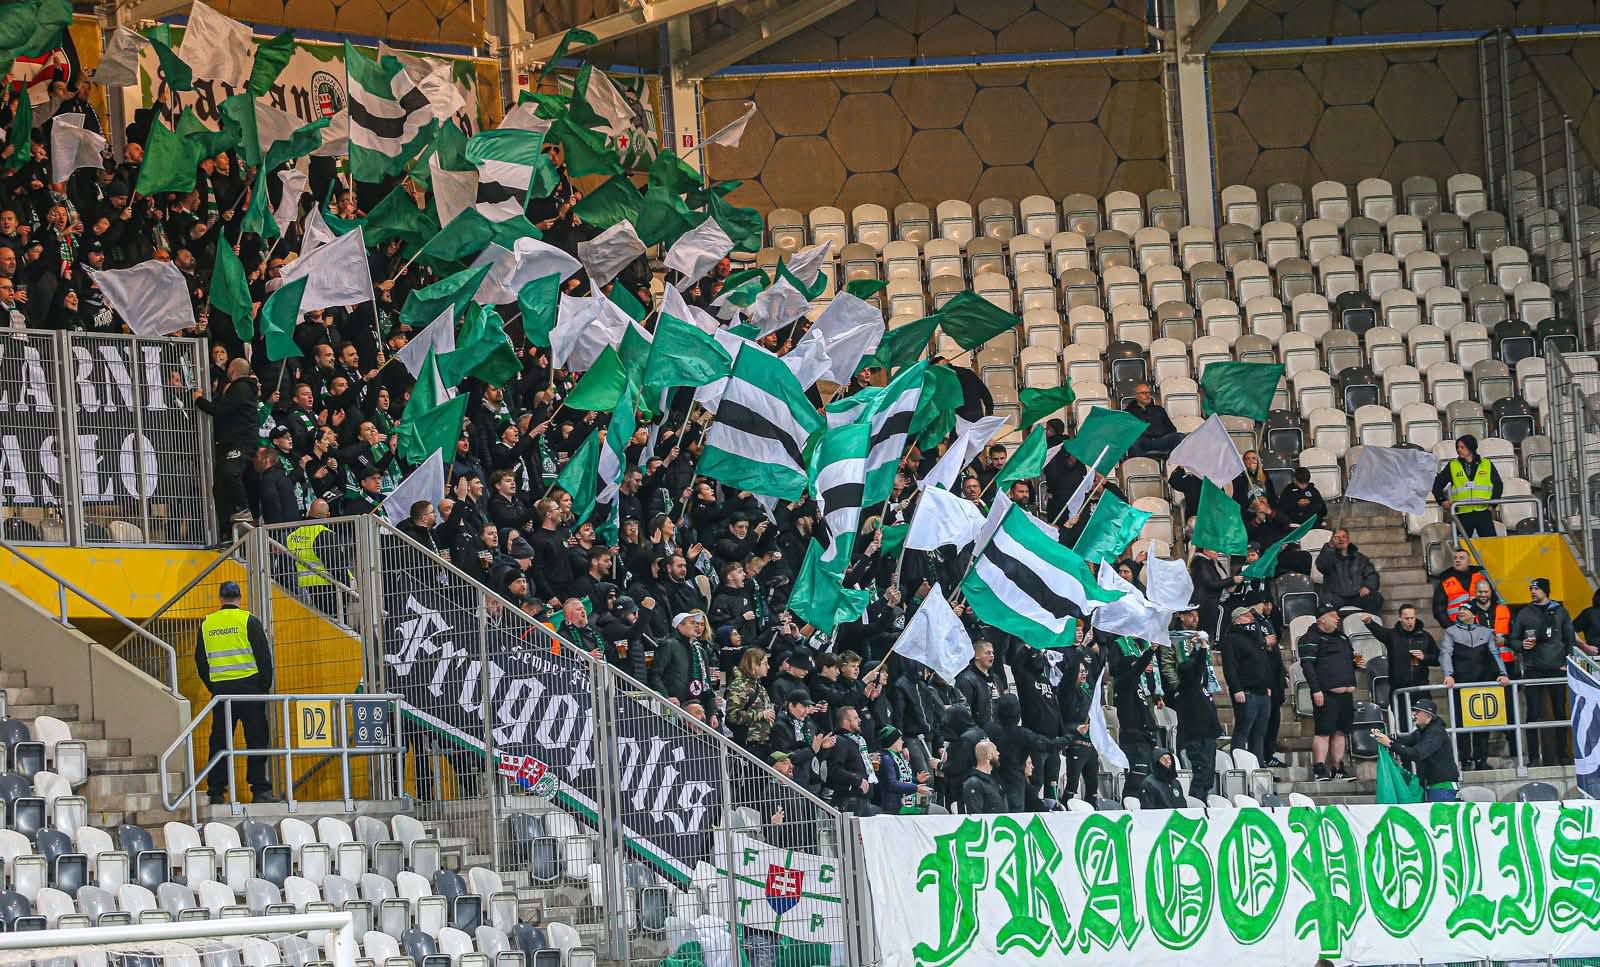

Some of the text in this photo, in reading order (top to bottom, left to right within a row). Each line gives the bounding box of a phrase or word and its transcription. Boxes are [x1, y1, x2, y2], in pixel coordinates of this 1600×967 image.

[0, 344, 169, 412] ARNI
[302, 707, 327, 740] D2
[1468, 692, 1499, 720] CD
[912, 802, 1600, 967] FRAGOPOLIS
